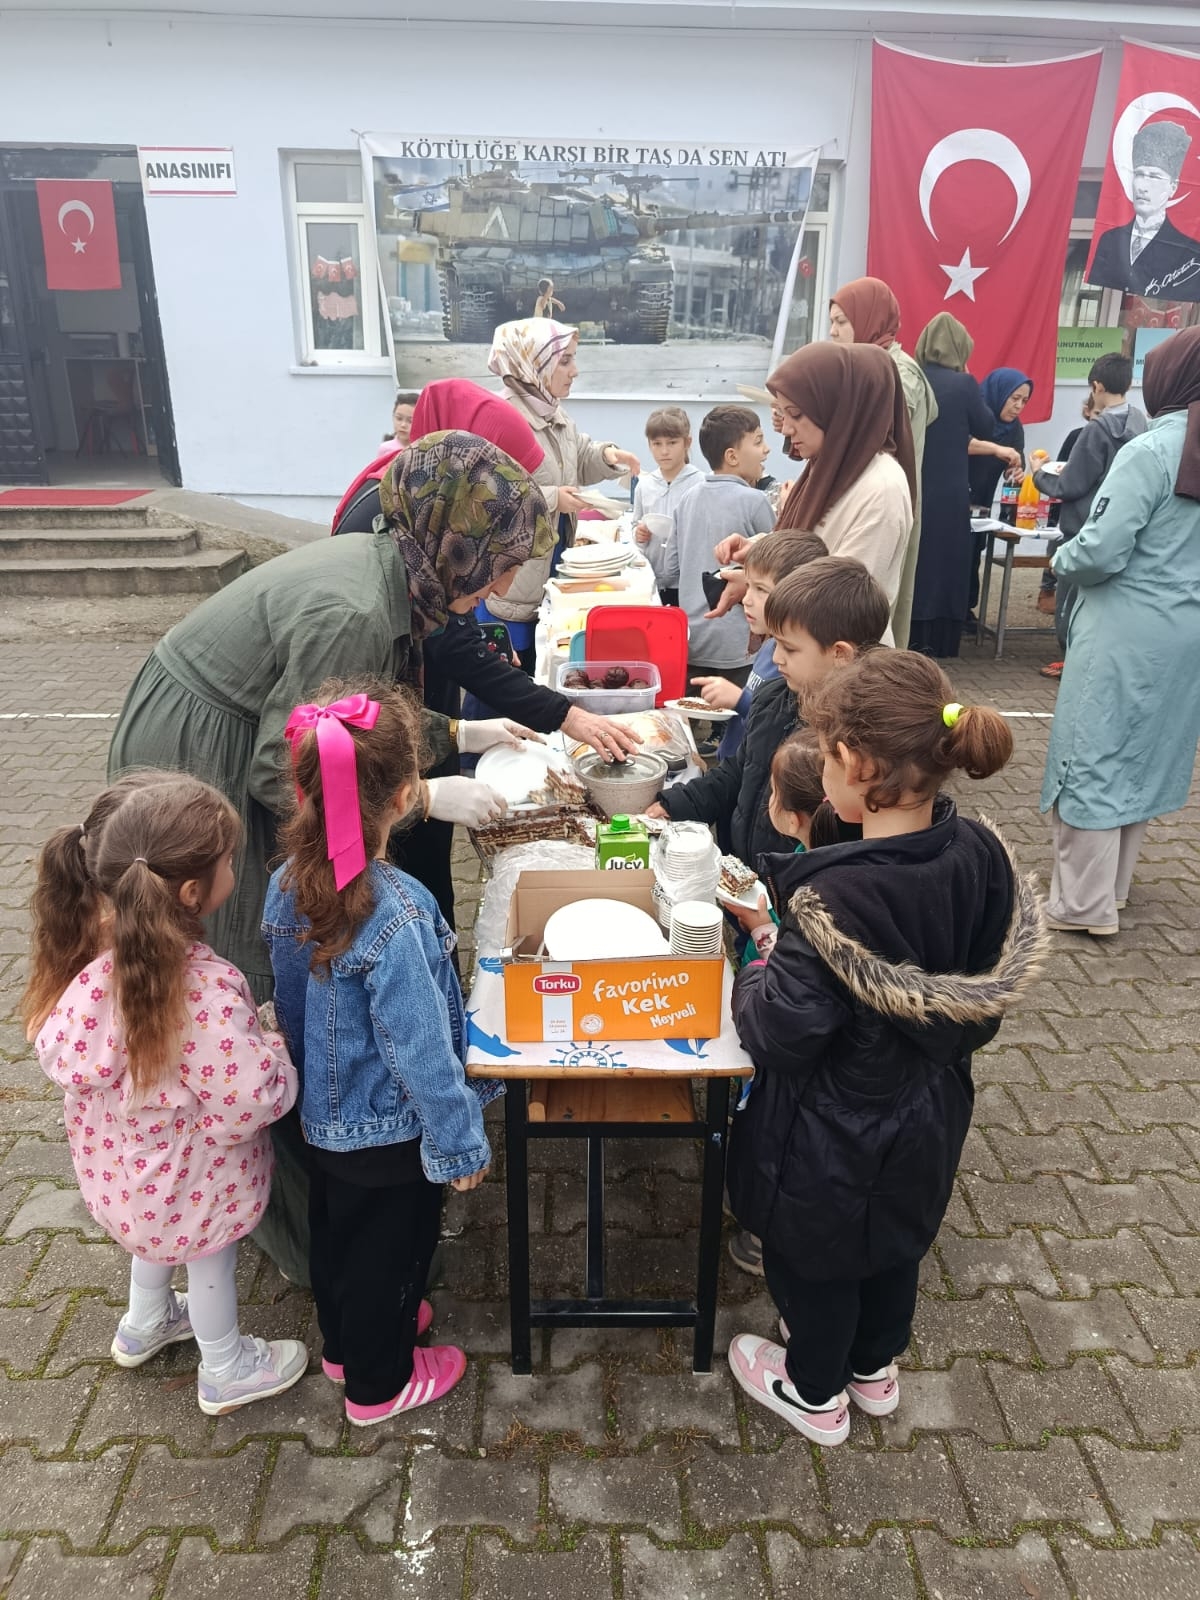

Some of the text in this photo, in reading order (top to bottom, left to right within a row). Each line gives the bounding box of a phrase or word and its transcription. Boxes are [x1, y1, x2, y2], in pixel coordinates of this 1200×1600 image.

[401, 138, 787, 168] KÖTÜLÜĞE KARŞI BİR TAŞ DA SEN AT!
[146, 162, 231, 178] ANASINIFI
[539, 978, 575, 990] Torku
[593, 972, 689, 1003] favorimo
[621, 993, 671, 1015] Kek
[649, 1003, 697, 1028] Meyveli
